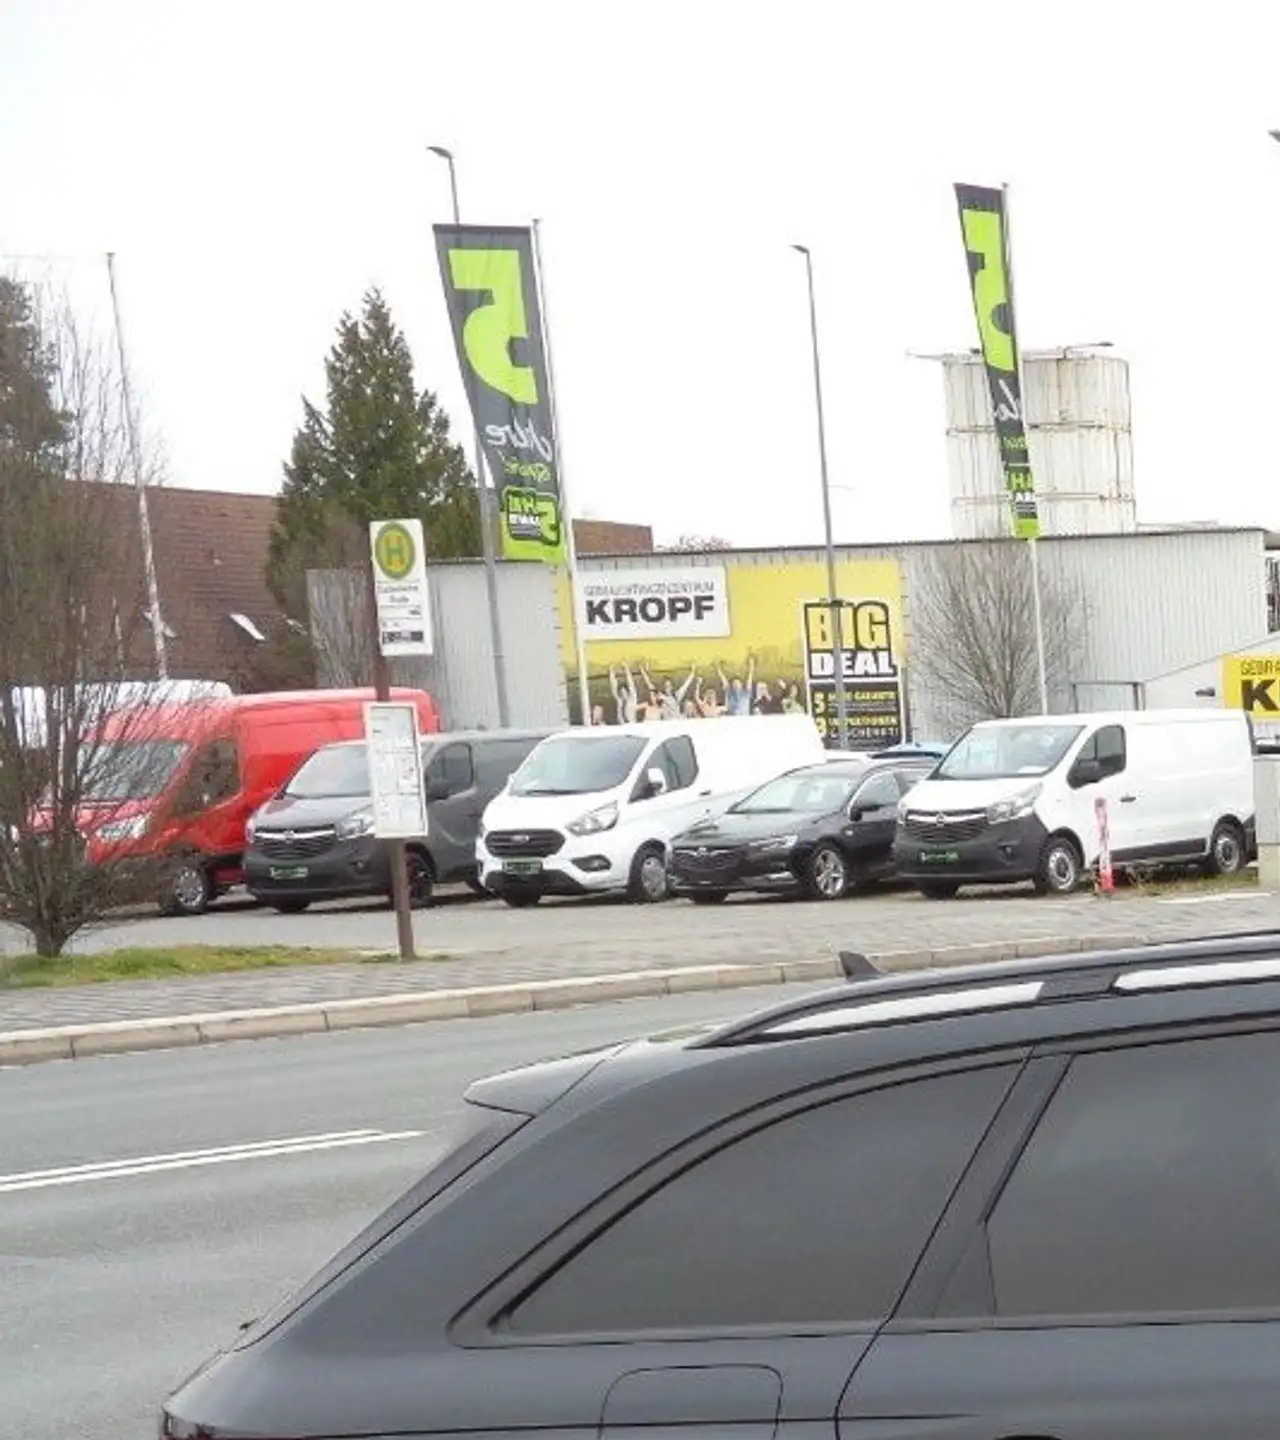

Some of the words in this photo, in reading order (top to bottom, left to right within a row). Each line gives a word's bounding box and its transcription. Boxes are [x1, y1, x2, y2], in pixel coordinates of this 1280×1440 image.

[586, 595, 714, 624] KROPF
[805, 602, 890, 651] BIG
[811, 651, 894, 676] DEAL
